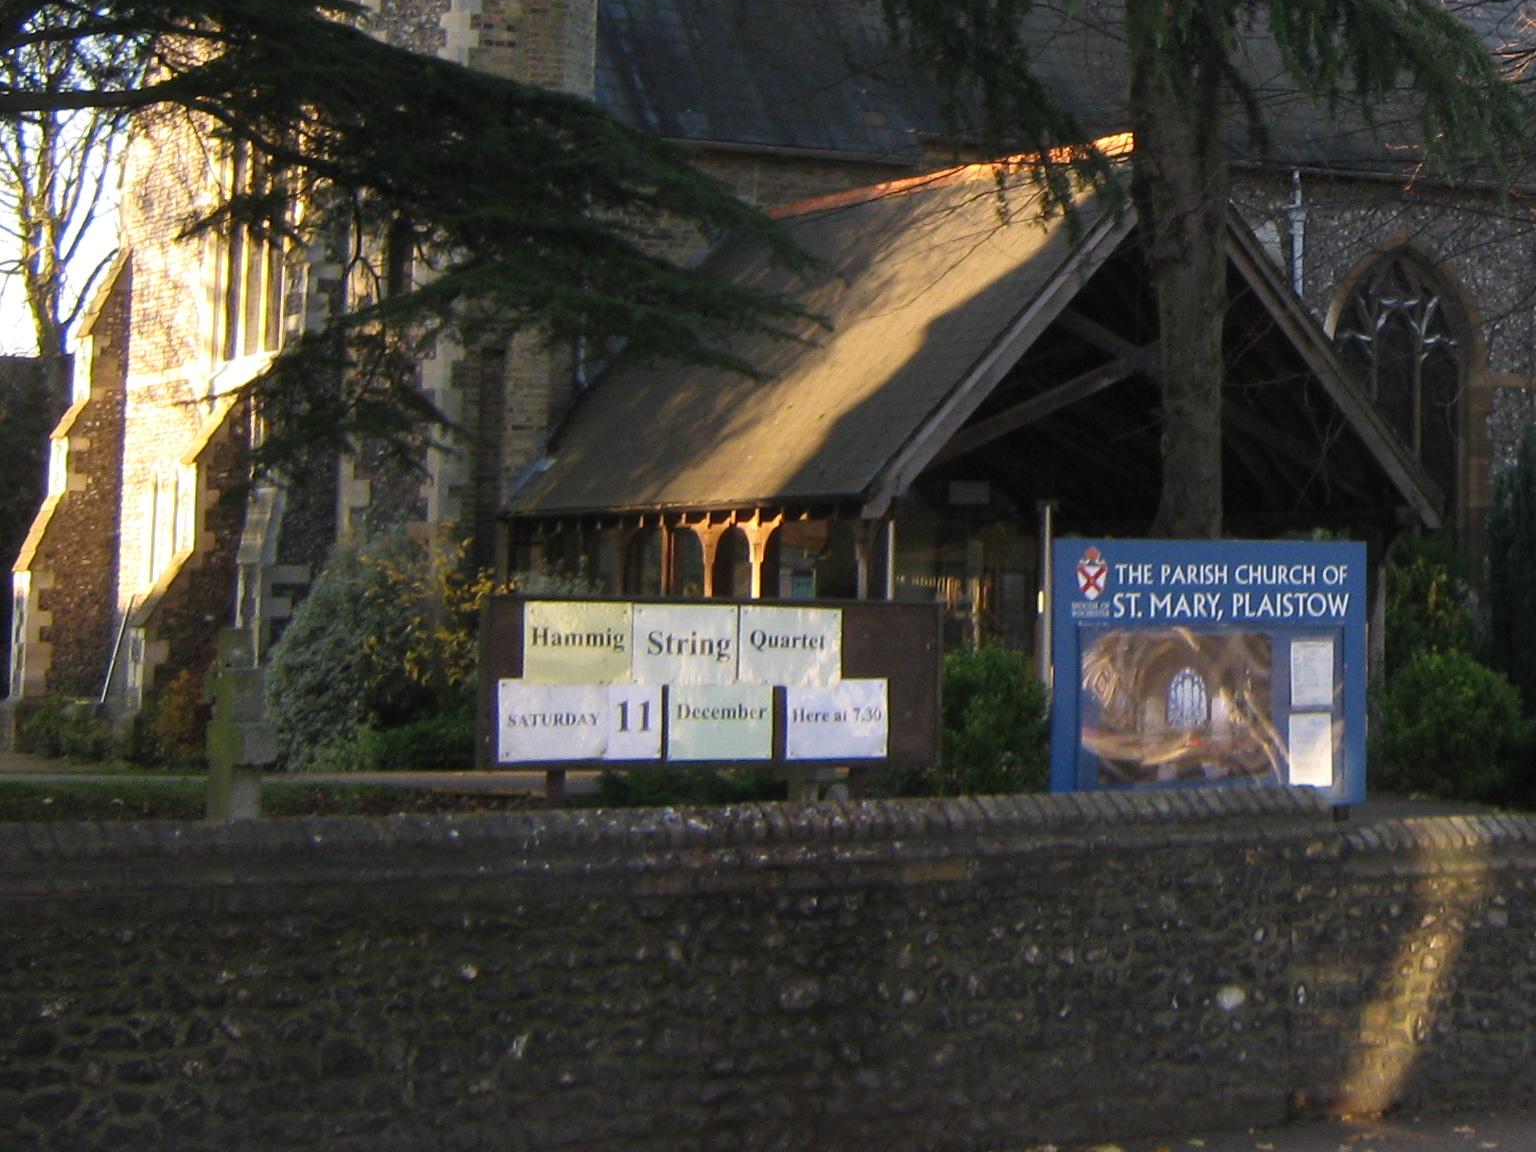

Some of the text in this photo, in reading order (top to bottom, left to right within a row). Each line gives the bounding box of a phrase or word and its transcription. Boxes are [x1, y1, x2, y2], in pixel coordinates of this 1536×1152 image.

[1114, 563, 1349, 586] THE PARISH CHURCH OF
[1113, 591, 1350, 622] ST. MARY, PLAISTOW
[531, 626, 826, 662] Hammig String Quartet
[507, 700, 882, 733] SATURDAY 11 December Here at 7.30
